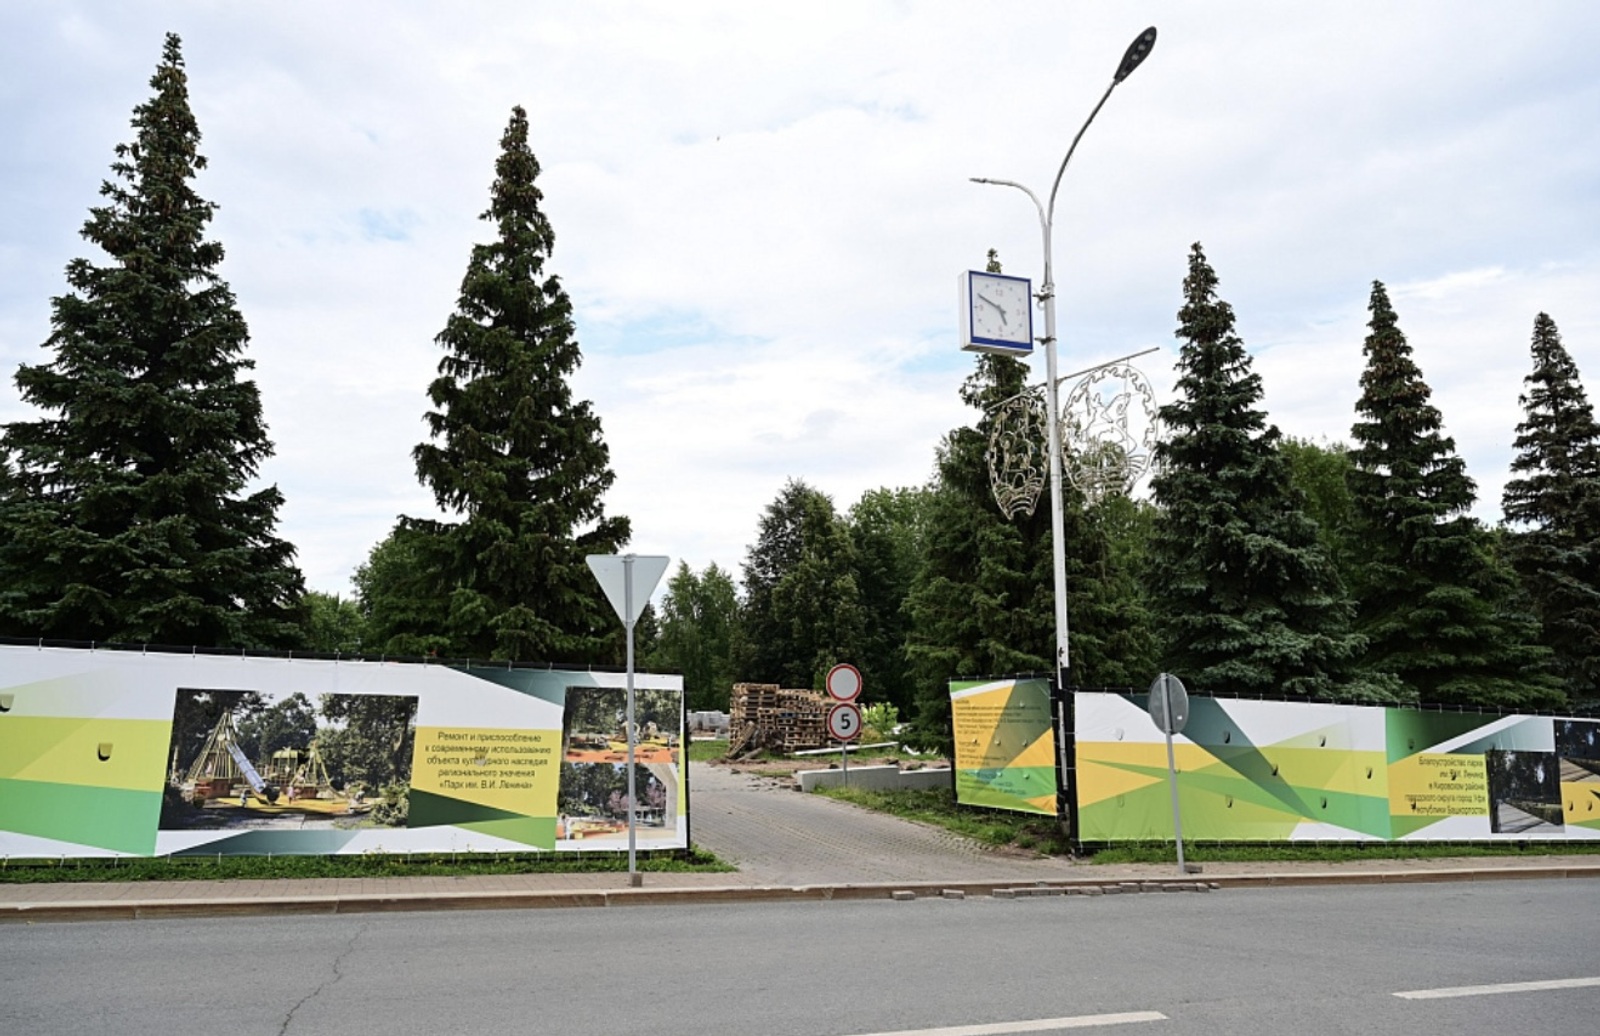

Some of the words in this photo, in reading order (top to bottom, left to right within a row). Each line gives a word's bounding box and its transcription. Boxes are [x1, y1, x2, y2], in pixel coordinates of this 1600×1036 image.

[841, 713, 851, 730] 5
[438, 731, 468, 741] Ремонт
[476, 733, 541, 743] приспособление
[431, 745, 489, 754] современному
[490, 746, 551, 754] использованию
[427, 754, 460, 765] объекта
[511, 757, 548, 767] наследия
[438, 769, 497, 778] регионального
[498, 769, 535, 778] значения
[498, 780, 533, 789] Ленина»
